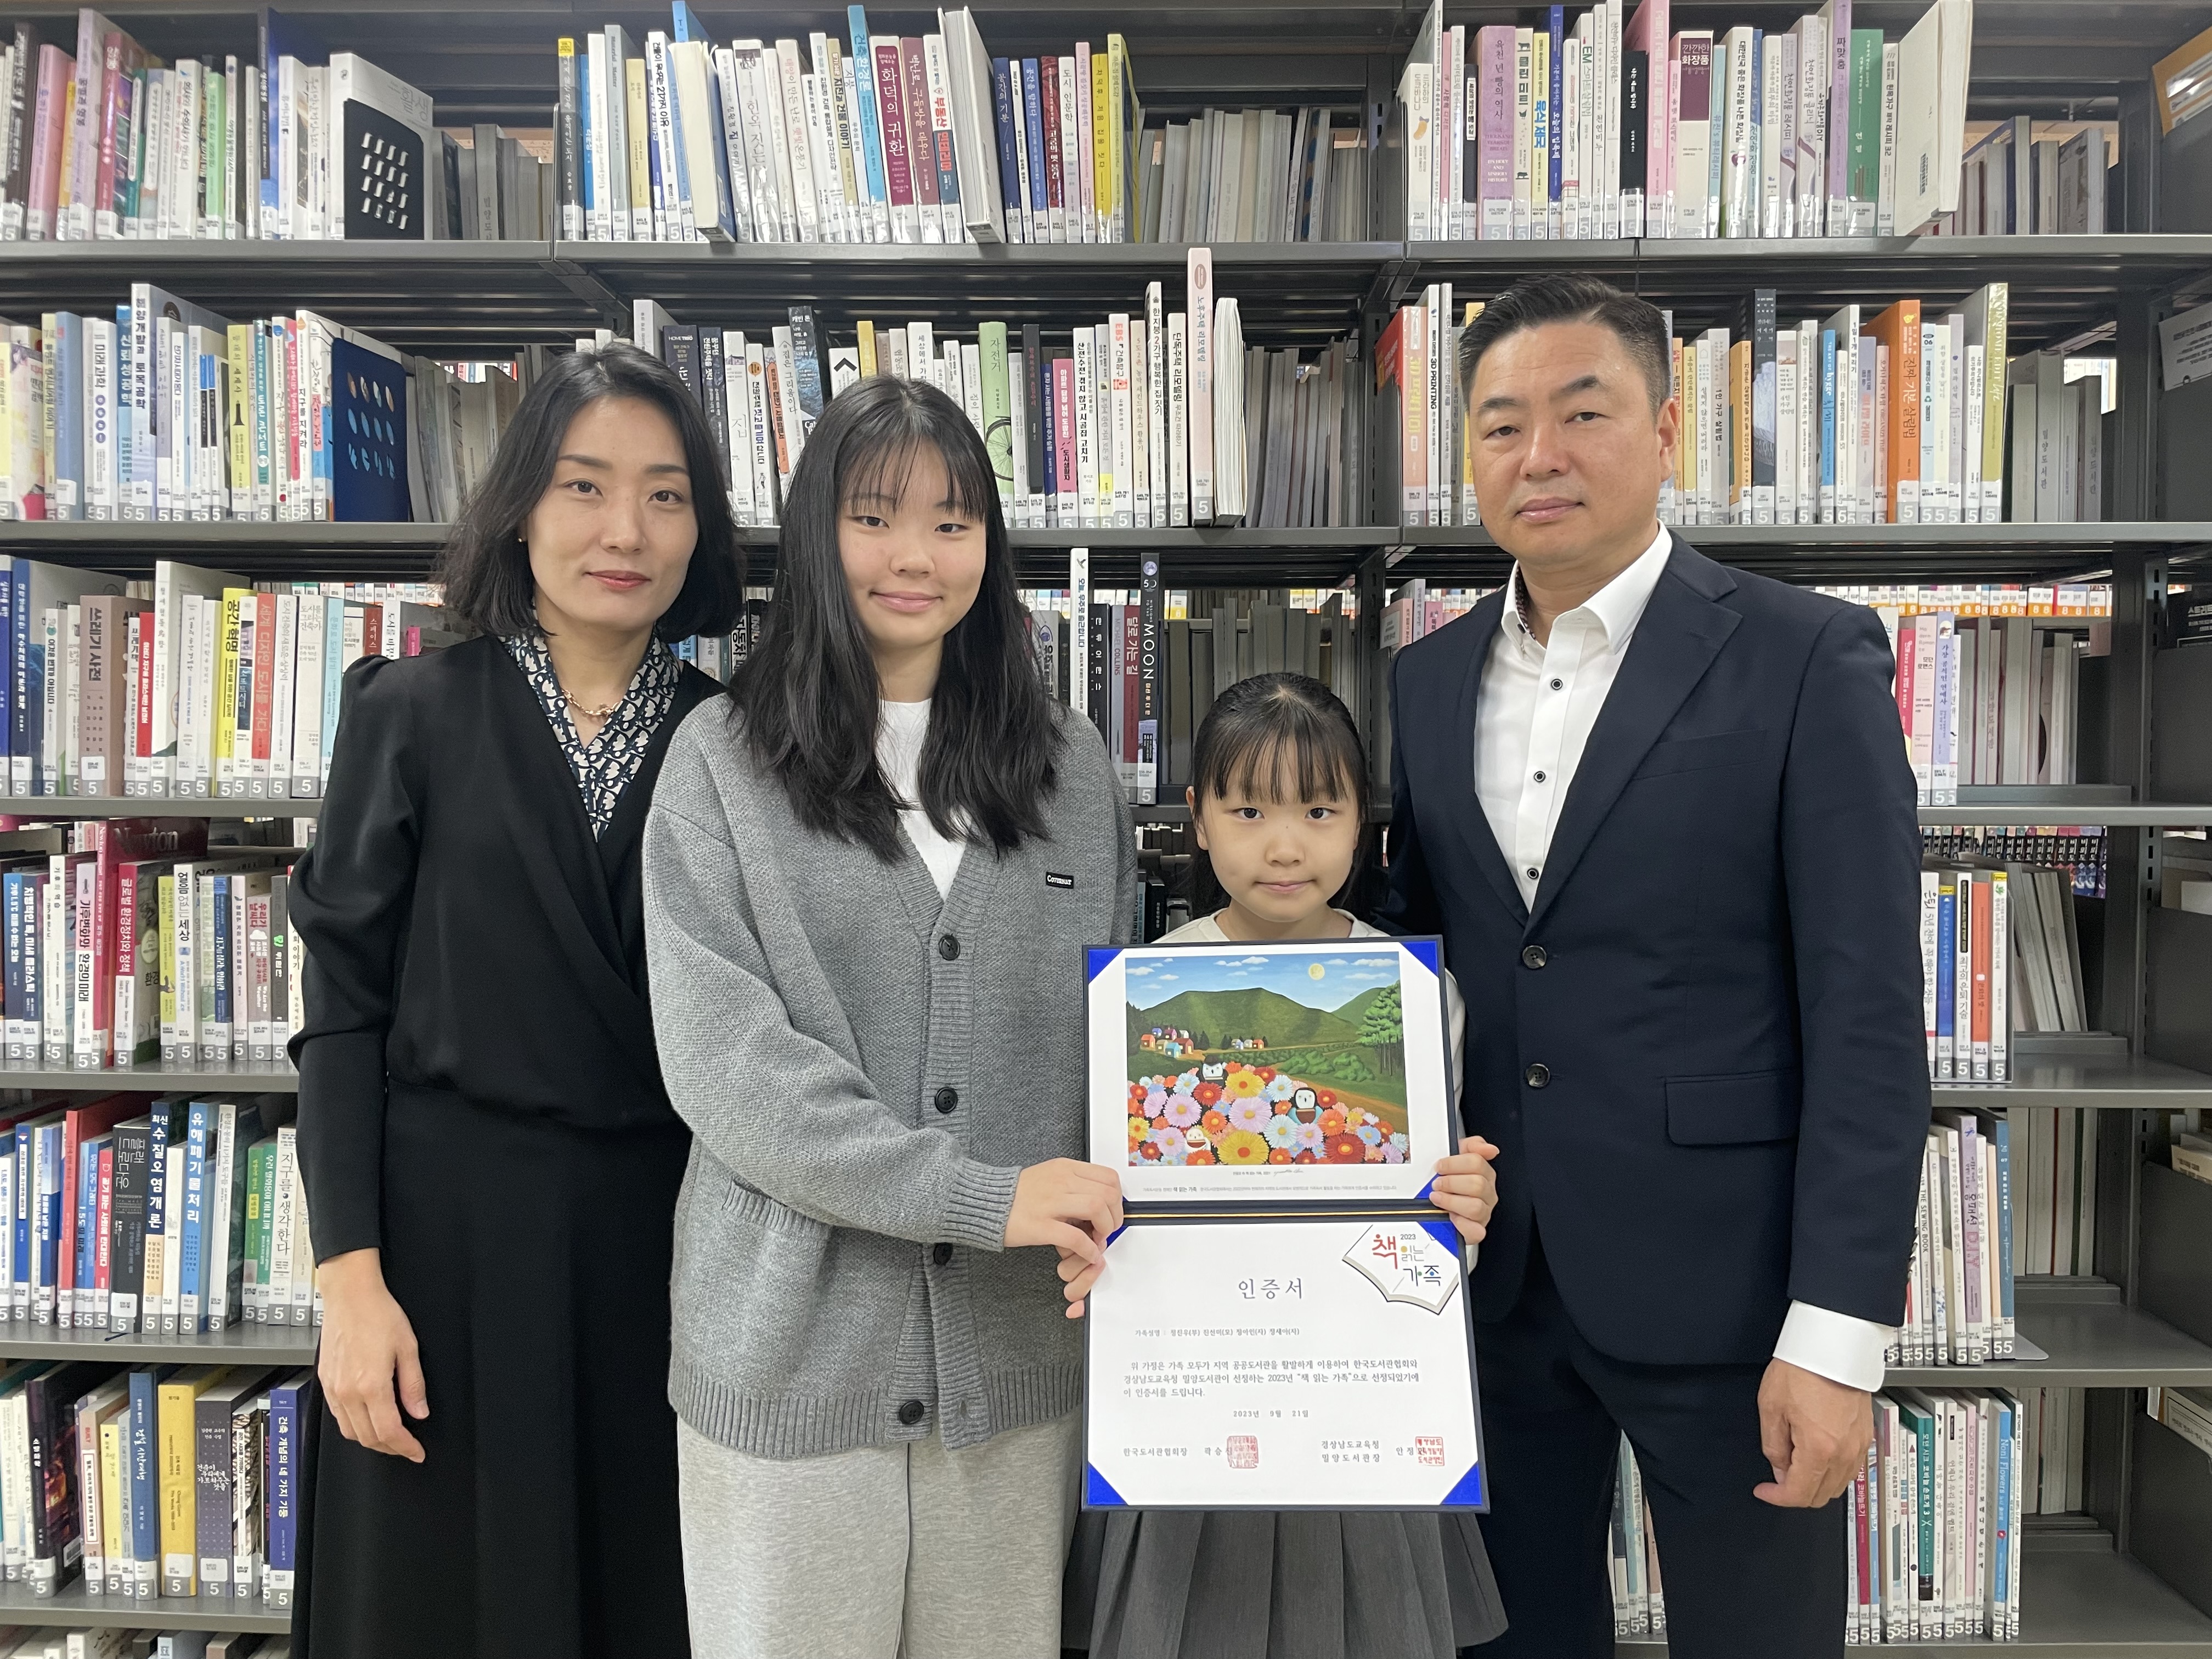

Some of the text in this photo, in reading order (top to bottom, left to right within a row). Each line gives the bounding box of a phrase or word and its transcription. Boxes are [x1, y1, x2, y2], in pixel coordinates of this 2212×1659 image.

[1583, 46, 1592, 63] EM
[1681, 55, 1709, 65] 화장품
[881, 67, 905, 156] 화덕의 귀환
[1491, 228, 1500, 240] 5
[991, 338, 1001, 372] 자전거
[1173, 332, 1181, 365] 단독주택
[1431, 358, 1437, 370] 3D
[1173, 369, 1182, 402] 리모델링
[1716, 390, 1722, 399] 1인
[1903, 358, 1916, 438] 진짜 기본 살림법
[1716, 403, 1722, 417] 가구
[1199, 500, 1208, 513] 5
[1904, 506, 1914, 520] 5
[226, 600, 239, 652] 공간 혁명
[89, 607, 101, 681] 쓰레기 사전
[258, 632, 269, 665] 디자인
[1126, 638, 1139, 663] 가는
[1143, 624, 1155, 679] MOON
[1126, 664, 1138, 675] 길
[88, 782, 97, 795] 5
[302, 780, 312, 792] 5
[1935, 791, 1944, 803] 5
[178, 873, 188, 894] 얼음
[259, 903, 267, 927] 우리가
[120, 878, 132, 972] 글로벌 환경정치와 정책
[179, 919, 190, 941] 세상
[78, 900, 91, 1001] 기후변화와 환경의 미래
[10, 1046, 20, 1057] 5
[118, 1051, 127, 1064] 5
[1942, 1061, 1951, 1074] 5
[151, 1115, 168, 1125] 최신
[116, 1137, 128, 1189] 드로다운
[1372, 1234, 1398, 1269] 책
[1403, 1265, 1441, 1286] 가족
[1238, 1278, 1302, 1299] 인증서
[146, 1317, 155, 1329] 5
[1938, 1347, 1947, 1359] 5
[1131, 1359, 1418, 1370] 위 가정은 가족 모두가 지역 공공도서관을 활발하게 이용하여 한국도서관협회와
[1183, 1374, 1229, 1384] 밀양도서관이
[1233, 1374, 1265, 1383] 선정하는
[1268, 1374, 1293, 1383] 2023년
[1124, 1389, 1131, 1397] 이
[1136, 1388, 1166, 1397] 인증서를
[278, 1417, 288, 1434] 건축
[278, 1437, 288, 1464] 개념의
[1999, 1439, 2008, 1493] Noni Flowers
[278, 1479, 288, 1497] 가지
[278, 1500, 288, 1517] 기둥
[172, 1579, 181, 1592] 5
[278, 1593, 288, 1605] 5
[1993, 1624, 2002, 1637] 5
